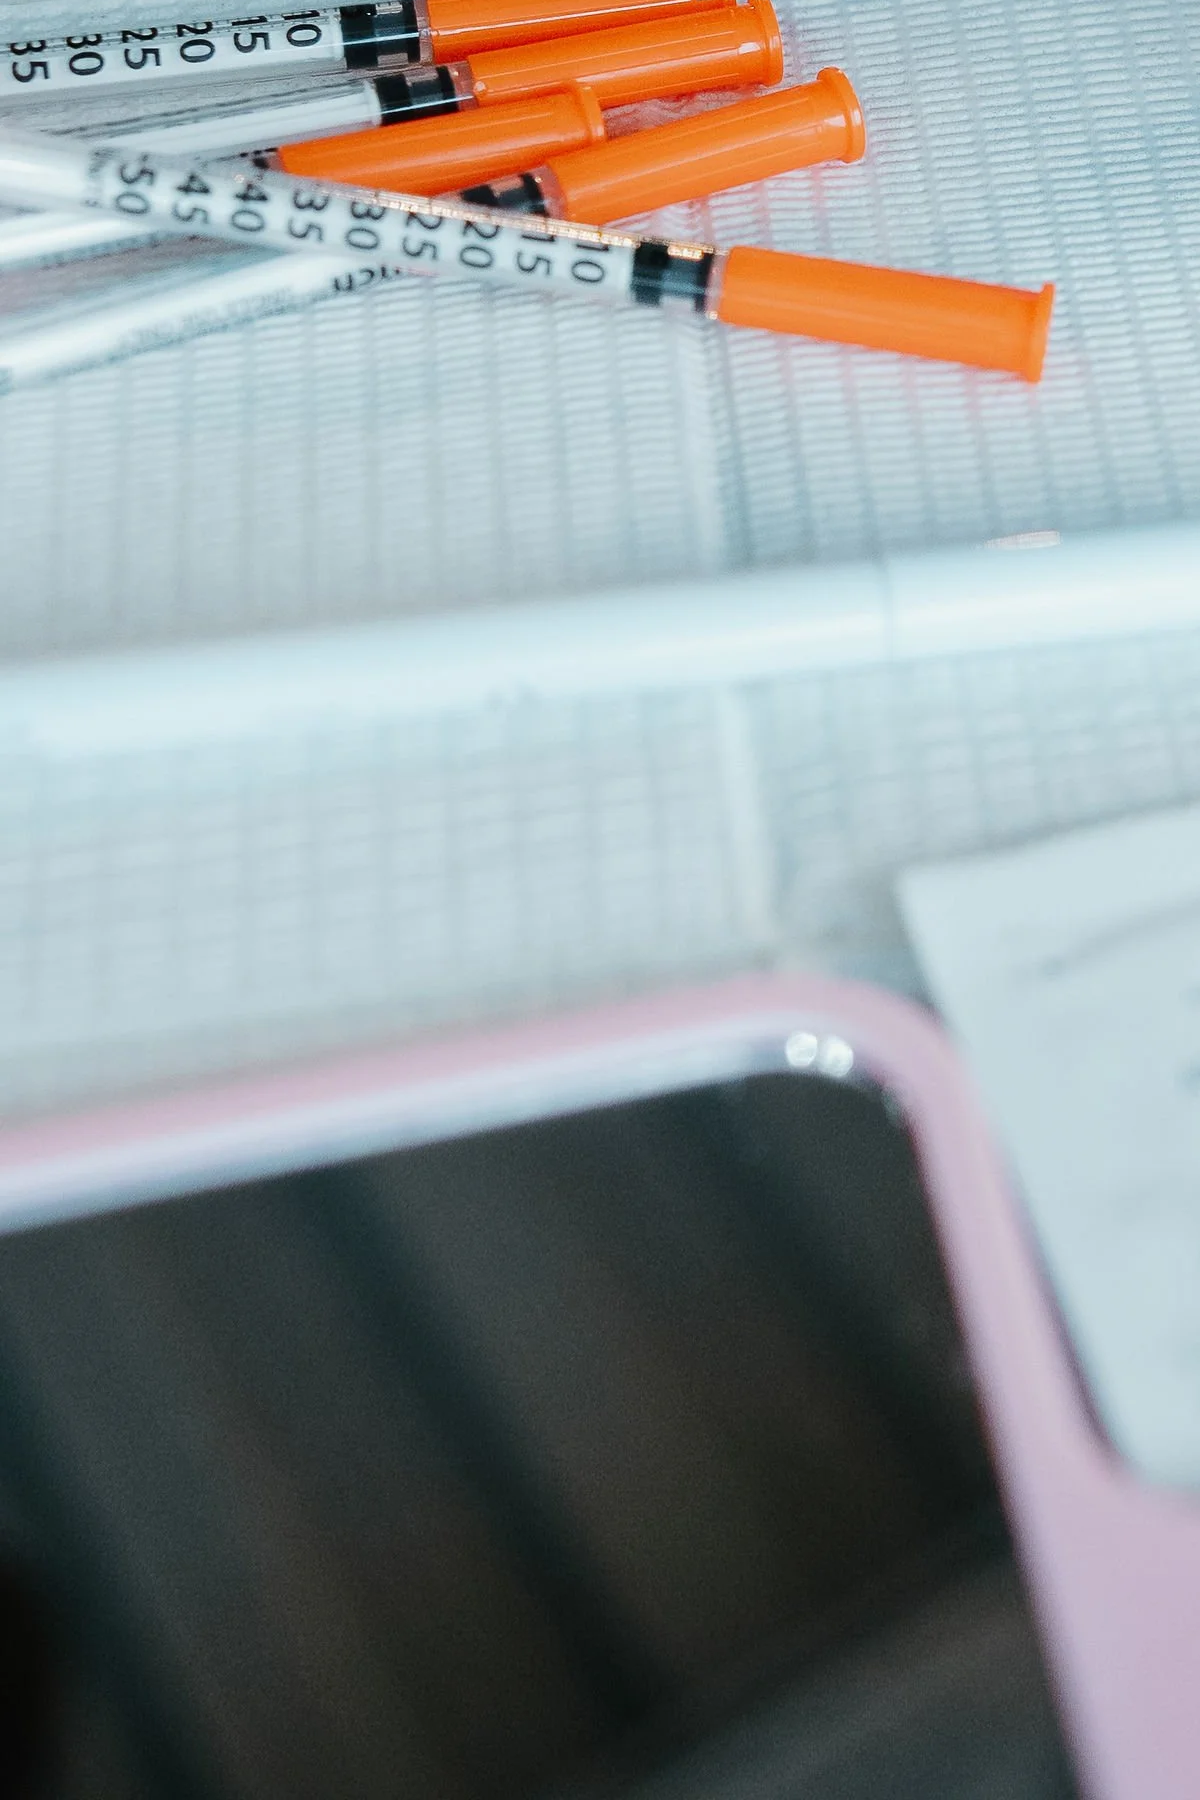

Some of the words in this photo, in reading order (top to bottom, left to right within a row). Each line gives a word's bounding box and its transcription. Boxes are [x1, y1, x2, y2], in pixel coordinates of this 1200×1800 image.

[122, 26, 161, 69] 25
[176, 21, 216, 63] 20
[232, 15, 271, 53] 15
[282, 10, 321, 47] 10
[10, 39, 50, 83] 35
[66, 33, 104, 75] 30
[115, 163, 155, 215] 50
[171, 173, 210, 224] 45
[230, 183, 269, 232] 40
[287, 190, 330, 242] 35
[345, 201, 386, 250] 30
[402, 211, 442, 260] 25
[459, 220, 502, 268] 20
[516, 233, 556, 275] 15
[571, 243, 609, 283] 10
